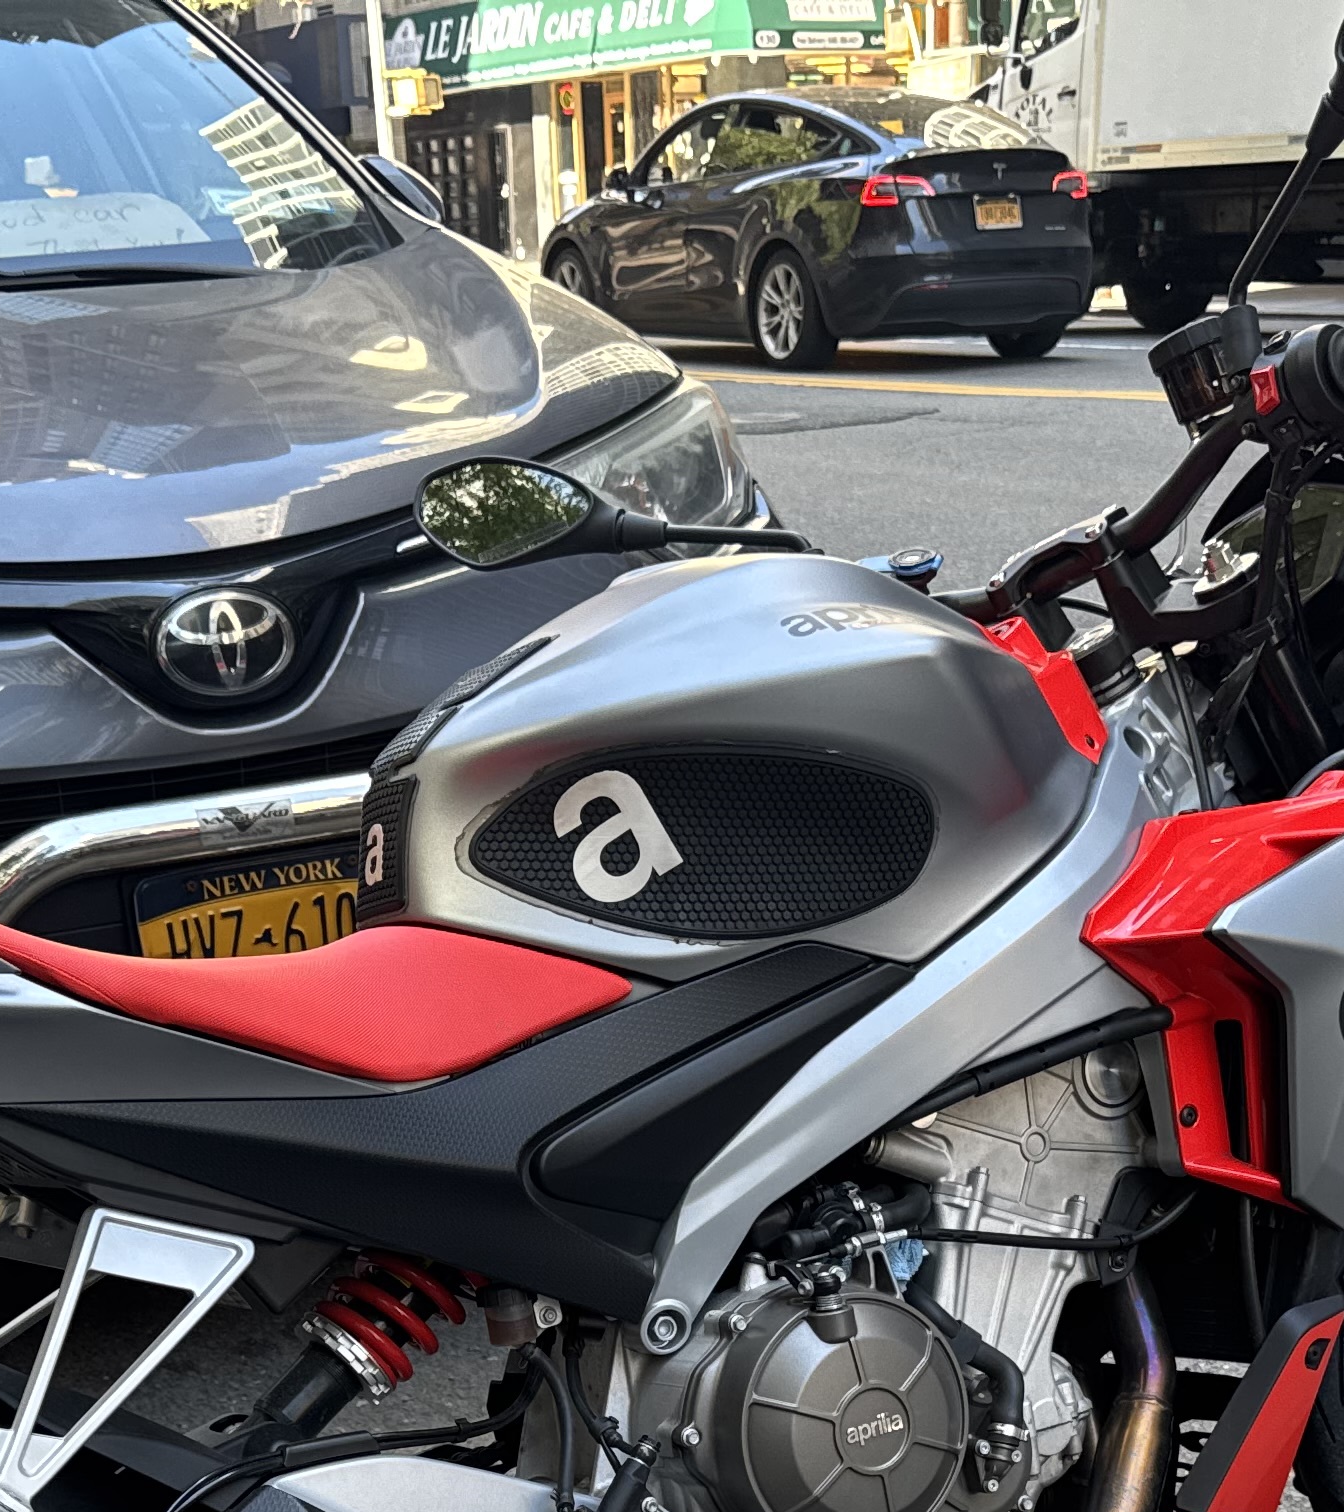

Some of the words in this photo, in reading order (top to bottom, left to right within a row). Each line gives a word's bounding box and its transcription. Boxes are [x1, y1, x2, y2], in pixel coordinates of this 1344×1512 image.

[424, 17, 453, 61] LE
[452, 1, 544, 63] JARDIN
[543, 6, 594, 44] CAFE
[597, 2, 614, 35] &
[618, 0, 676, 32] DELI
[1014, 94, 1053, 124] TOTAL
[73, 202, 141, 223] car
[364, 823, 384, 886] a
[553, 769, 684, 904] a
[201, 869, 266, 900] NEW
[272, 856, 343, 887] YORK
[846, 1411, 904, 1446] aprilia
